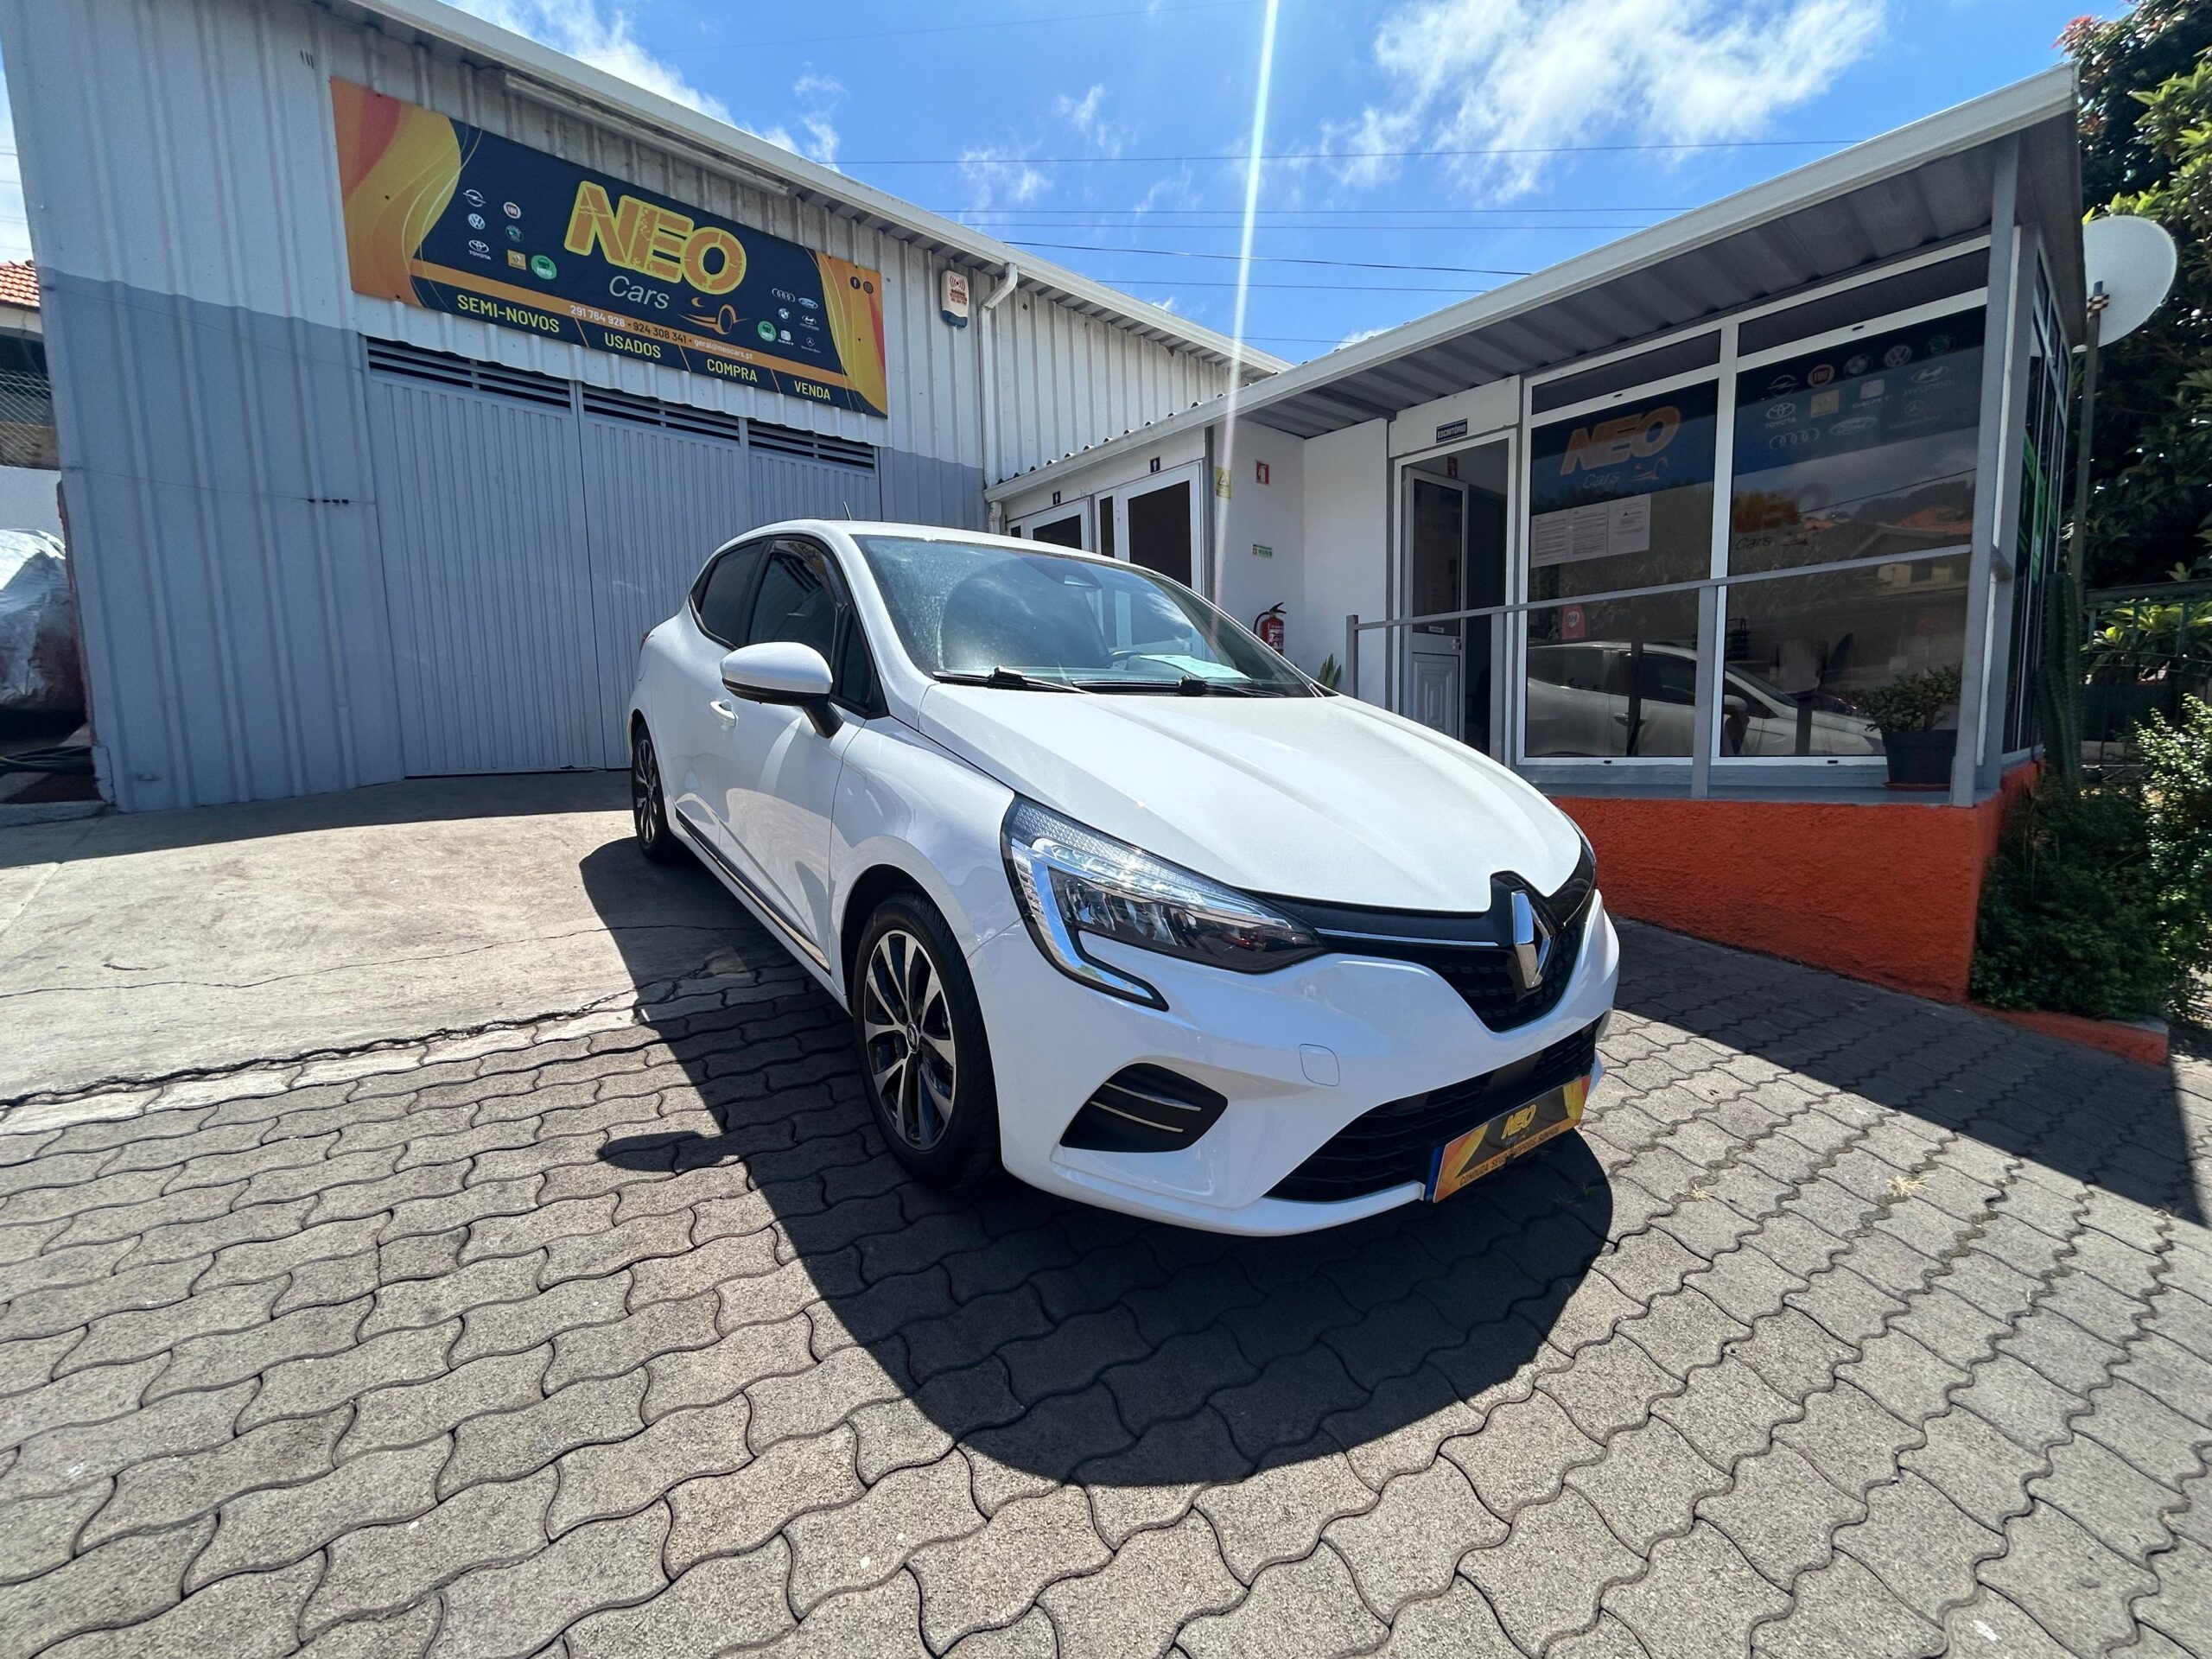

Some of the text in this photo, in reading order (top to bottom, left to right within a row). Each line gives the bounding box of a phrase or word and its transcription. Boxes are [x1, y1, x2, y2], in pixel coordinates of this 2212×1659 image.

[564, 181, 747, 295] NEO
[468, 250, 491, 260] TOYOTA
[609, 276, 671, 309] Cars
[457, 295, 560, 334] SEMI-NOVOS
[570, 305, 753, 361] 291 764 928 924 308 341 geral@neocars.pt
[605, 333, 662, 359] USADOS
[707, 359, 758, 382] COMPRA
[1814, 370, 1829, 384] FIAT
[794, 380, 831, 400] VENDA
[1437, 423, 1466, 439] ESCRITÓRIO
[1765, 416, 1796, 428] TOYOTA
[1560, 406, 1681, 475] NEO
[1582, 471, 1621, 489] Cars
[1501, 1104, 1536, 1140] NEO
[1459, 1163, 1489, 1186] CONDUZA
